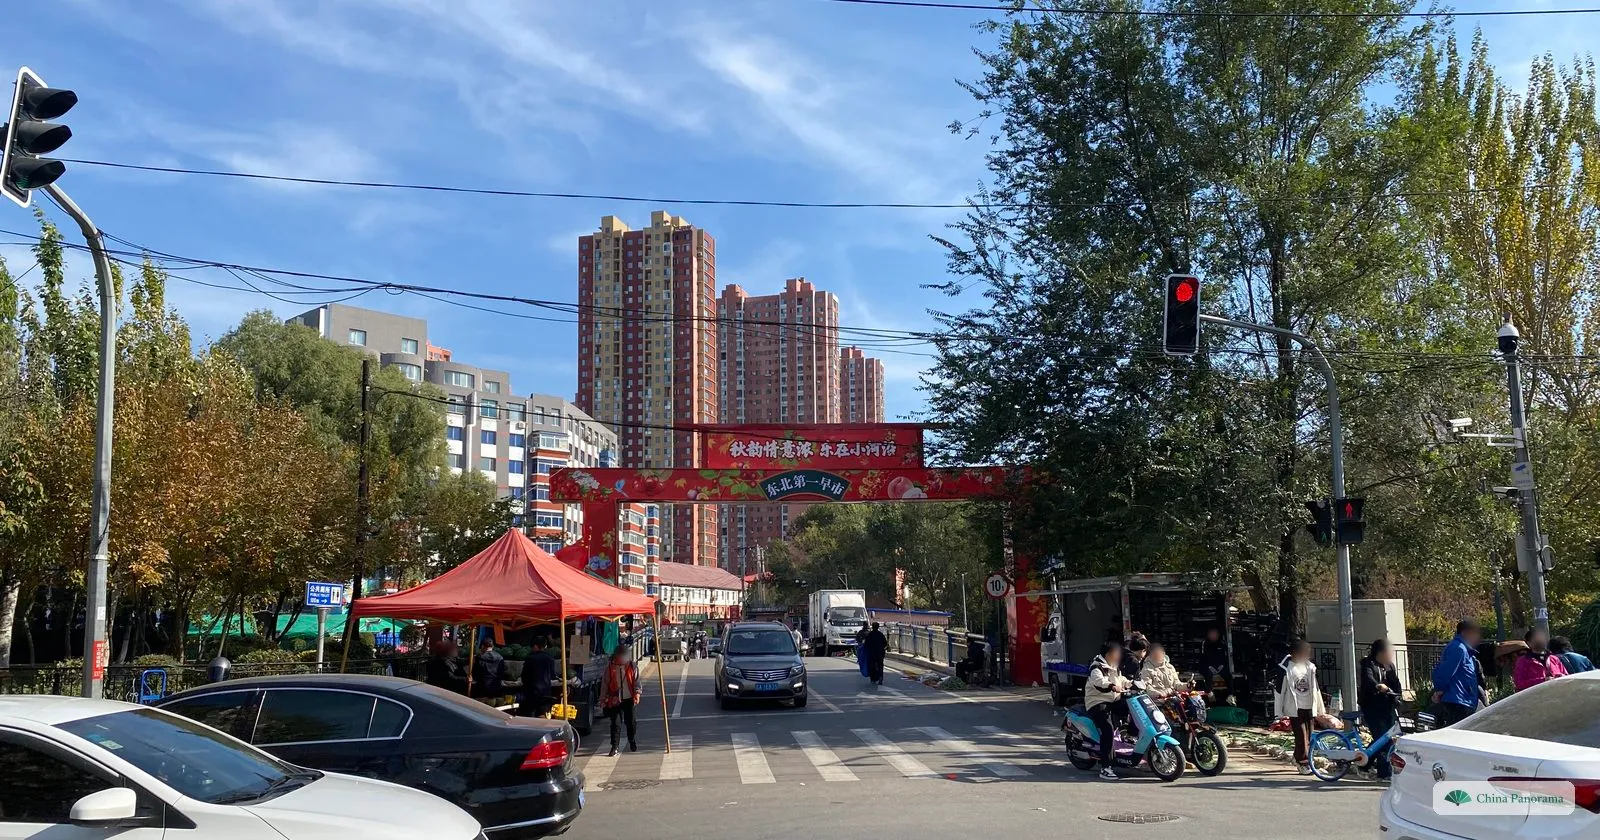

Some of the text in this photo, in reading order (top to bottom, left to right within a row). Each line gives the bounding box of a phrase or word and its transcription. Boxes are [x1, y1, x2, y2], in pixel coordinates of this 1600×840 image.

[729, 439, 897, 458] 秋韵情意浓 乐在小河沿
[765, 474, 845, 497] 东北第一早市
